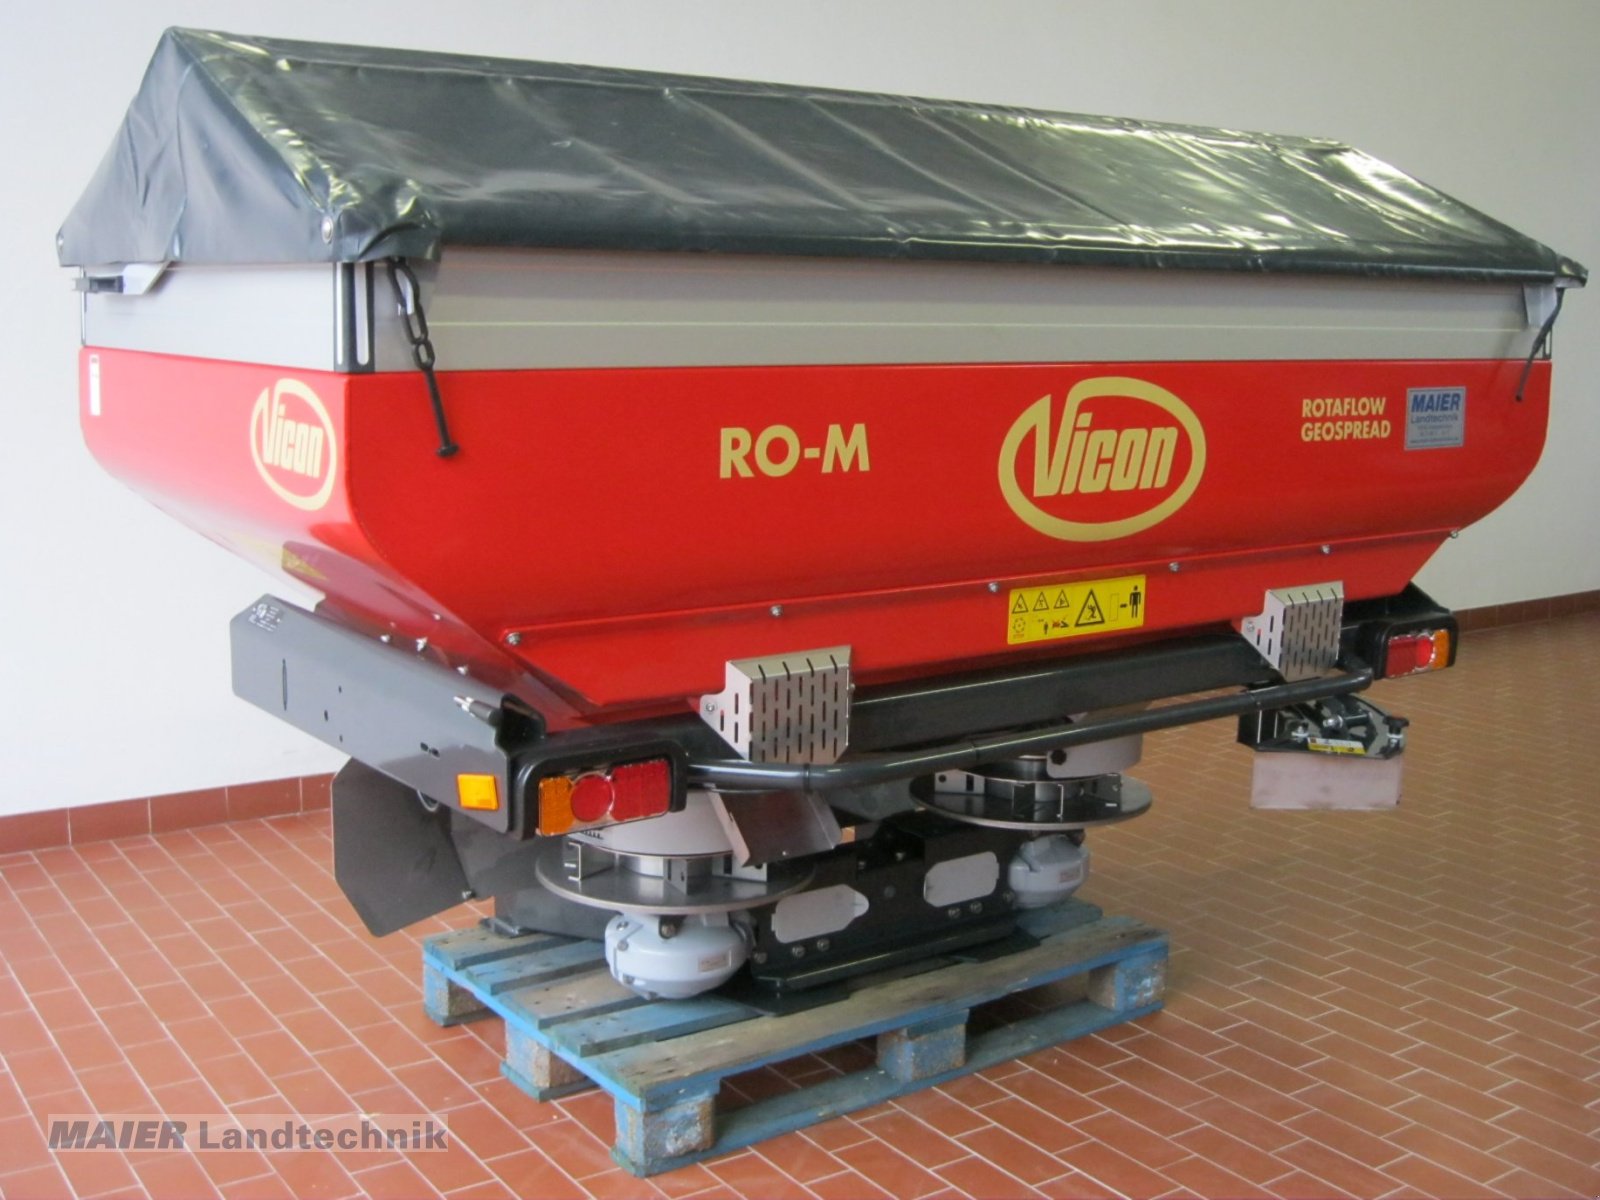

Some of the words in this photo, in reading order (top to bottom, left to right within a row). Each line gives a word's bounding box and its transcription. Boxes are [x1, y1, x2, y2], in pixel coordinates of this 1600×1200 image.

[1302, 397, 1387, 418] ROTAFLOW
[1411, 393, 1461, 412] MAIER
[261, 386, 324, 479] Vicon
[1033, 394, 1179, 498] Vicon
[1301, 420, 1392, 442] GEOSPREAD
[719, 423, 871, 480] RO-M
